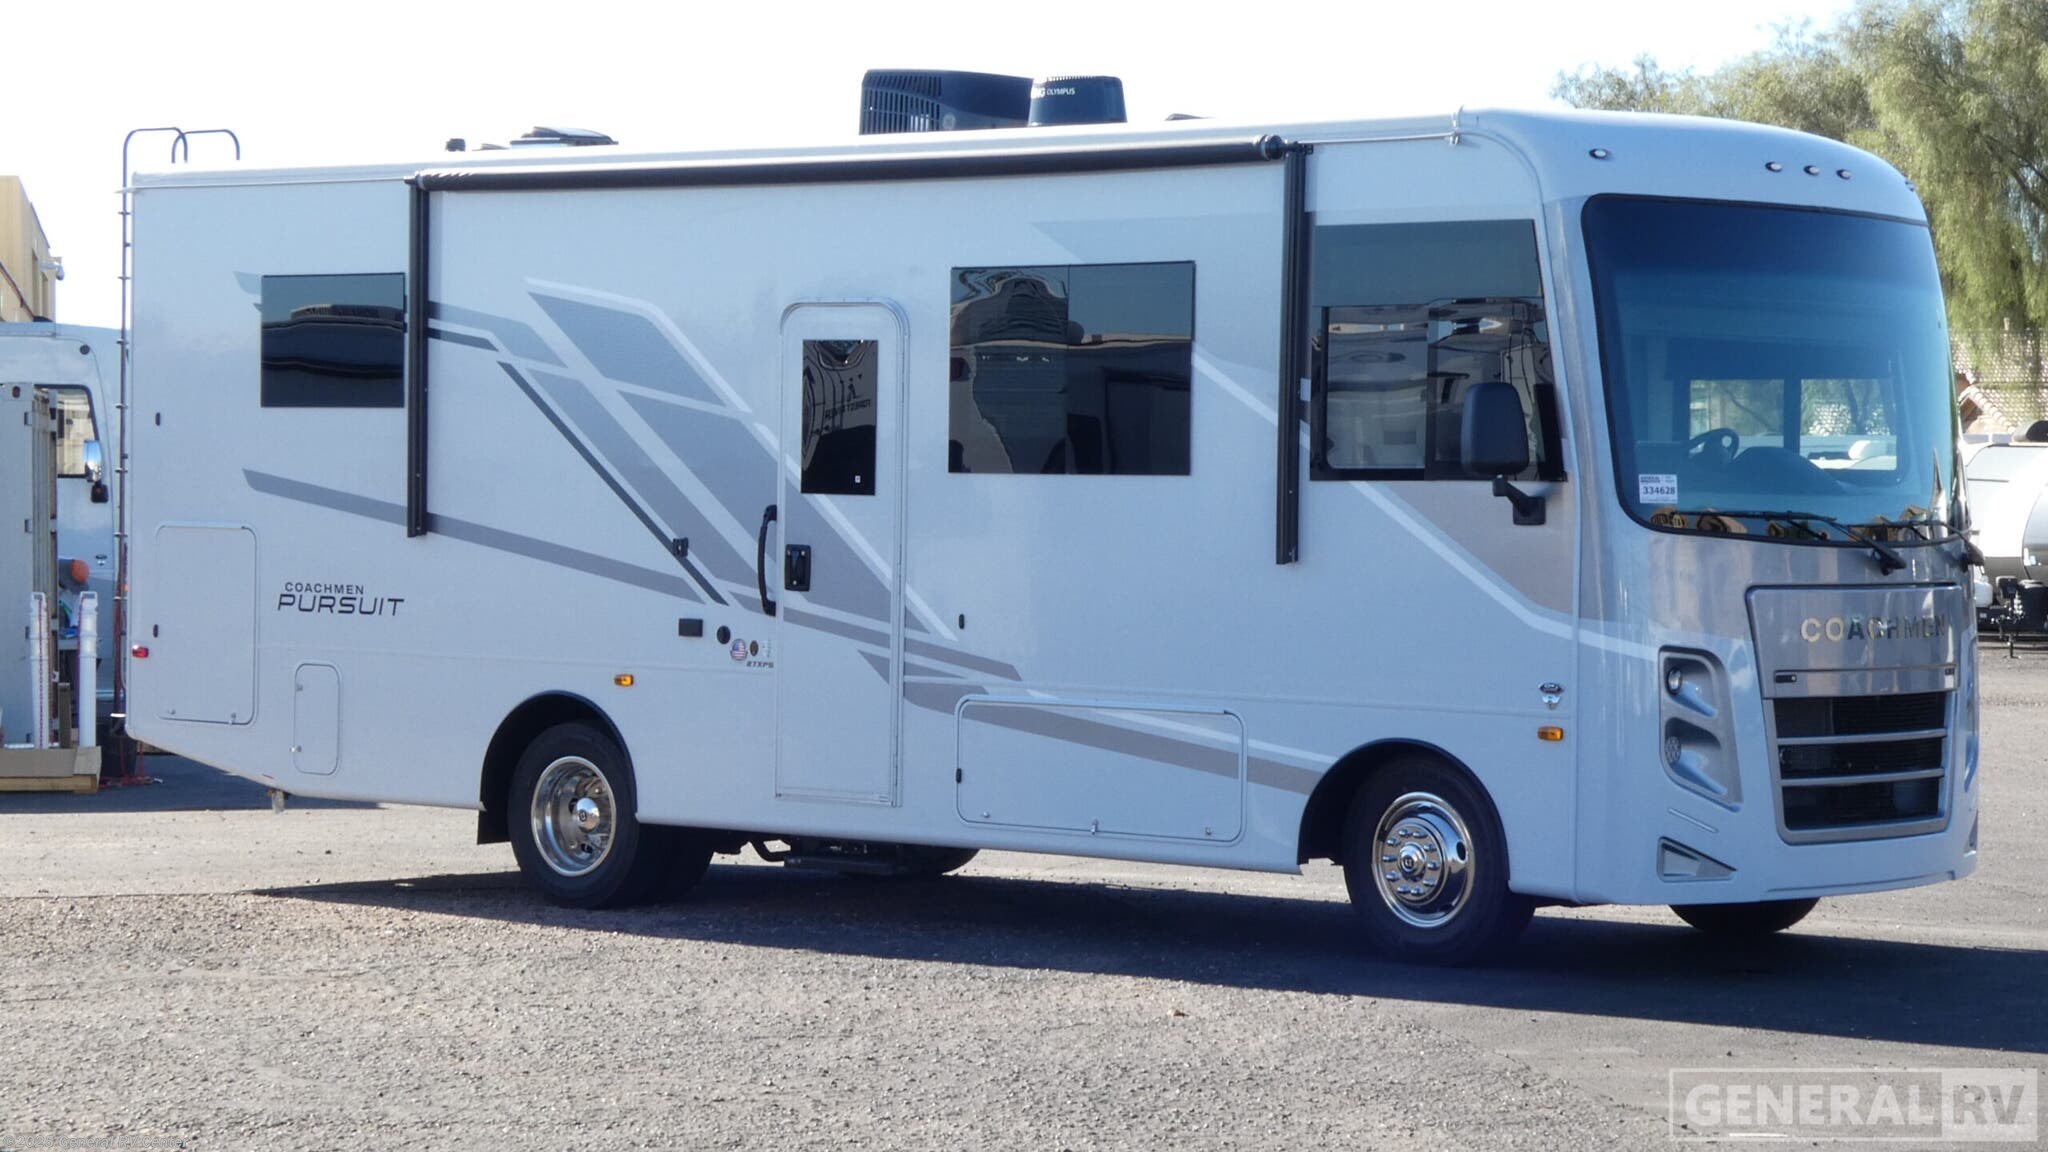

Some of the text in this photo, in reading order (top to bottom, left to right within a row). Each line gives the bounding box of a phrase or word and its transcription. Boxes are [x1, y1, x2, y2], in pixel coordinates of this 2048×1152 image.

[1046, 87, 1075, 96] OLYMPUS
[1643, 486, 1676, 495] 334628
[285, 582, 364, 595] COACHMEN
[277, 593, 405, 616] PURSUIT
[1801, 616, 1945, 643] COACHMEN
